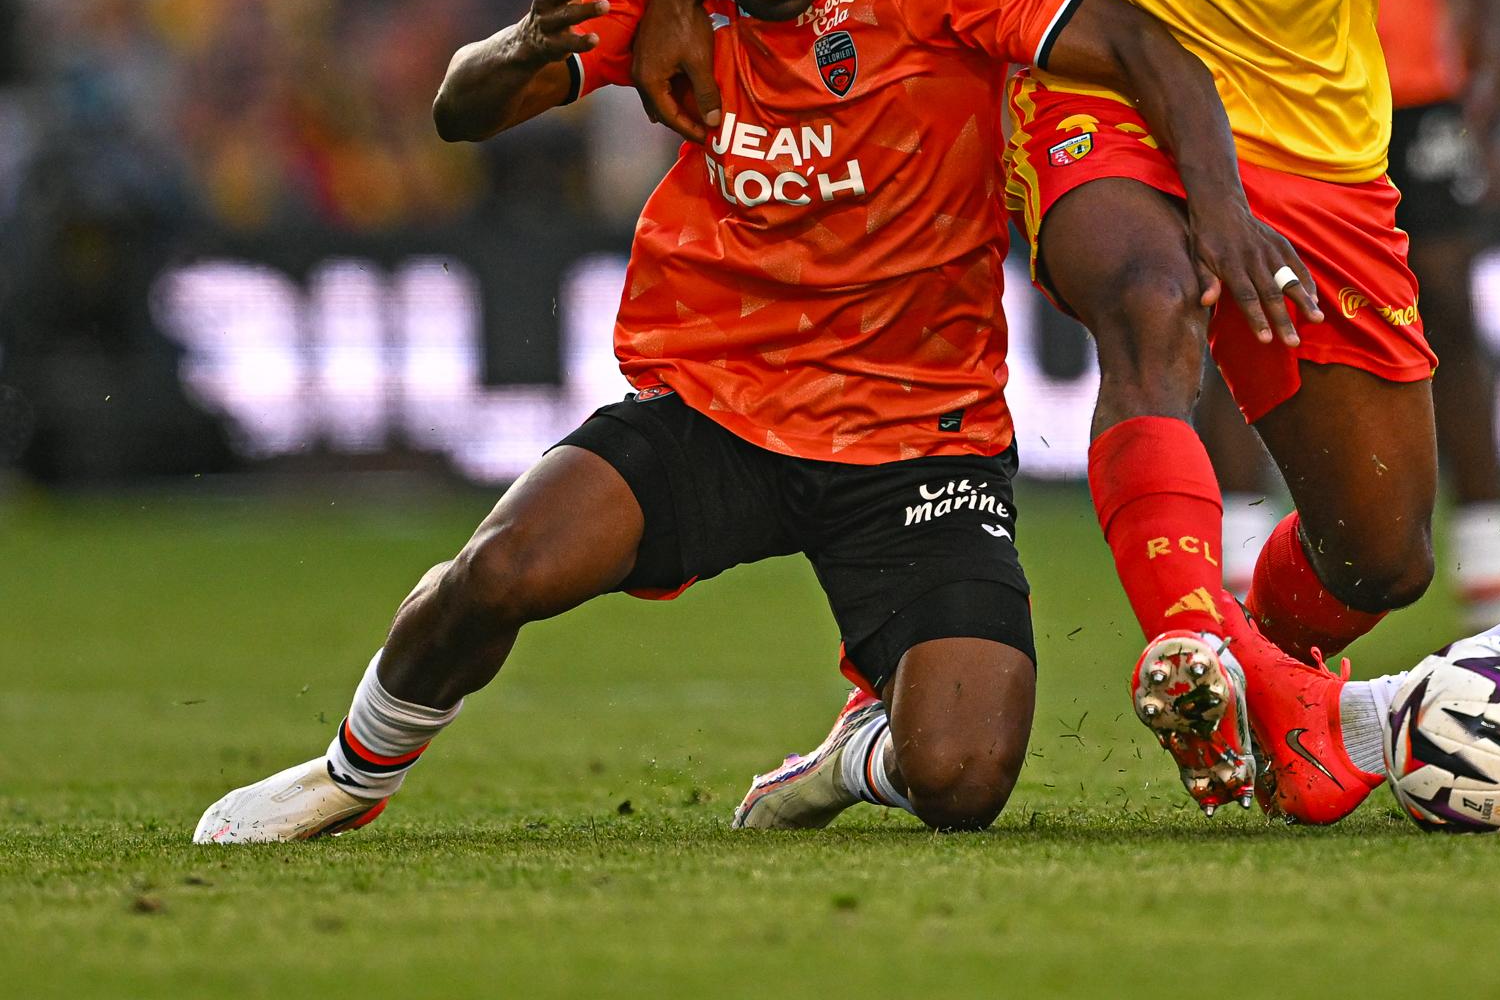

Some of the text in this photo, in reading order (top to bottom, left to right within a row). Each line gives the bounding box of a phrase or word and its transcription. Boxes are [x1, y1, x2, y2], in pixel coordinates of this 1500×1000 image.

[712, 112, 832, 166] JEAN
[705, 152, 865, 207] FLOC'H
[1146, 535, 1218, 567] RCL
